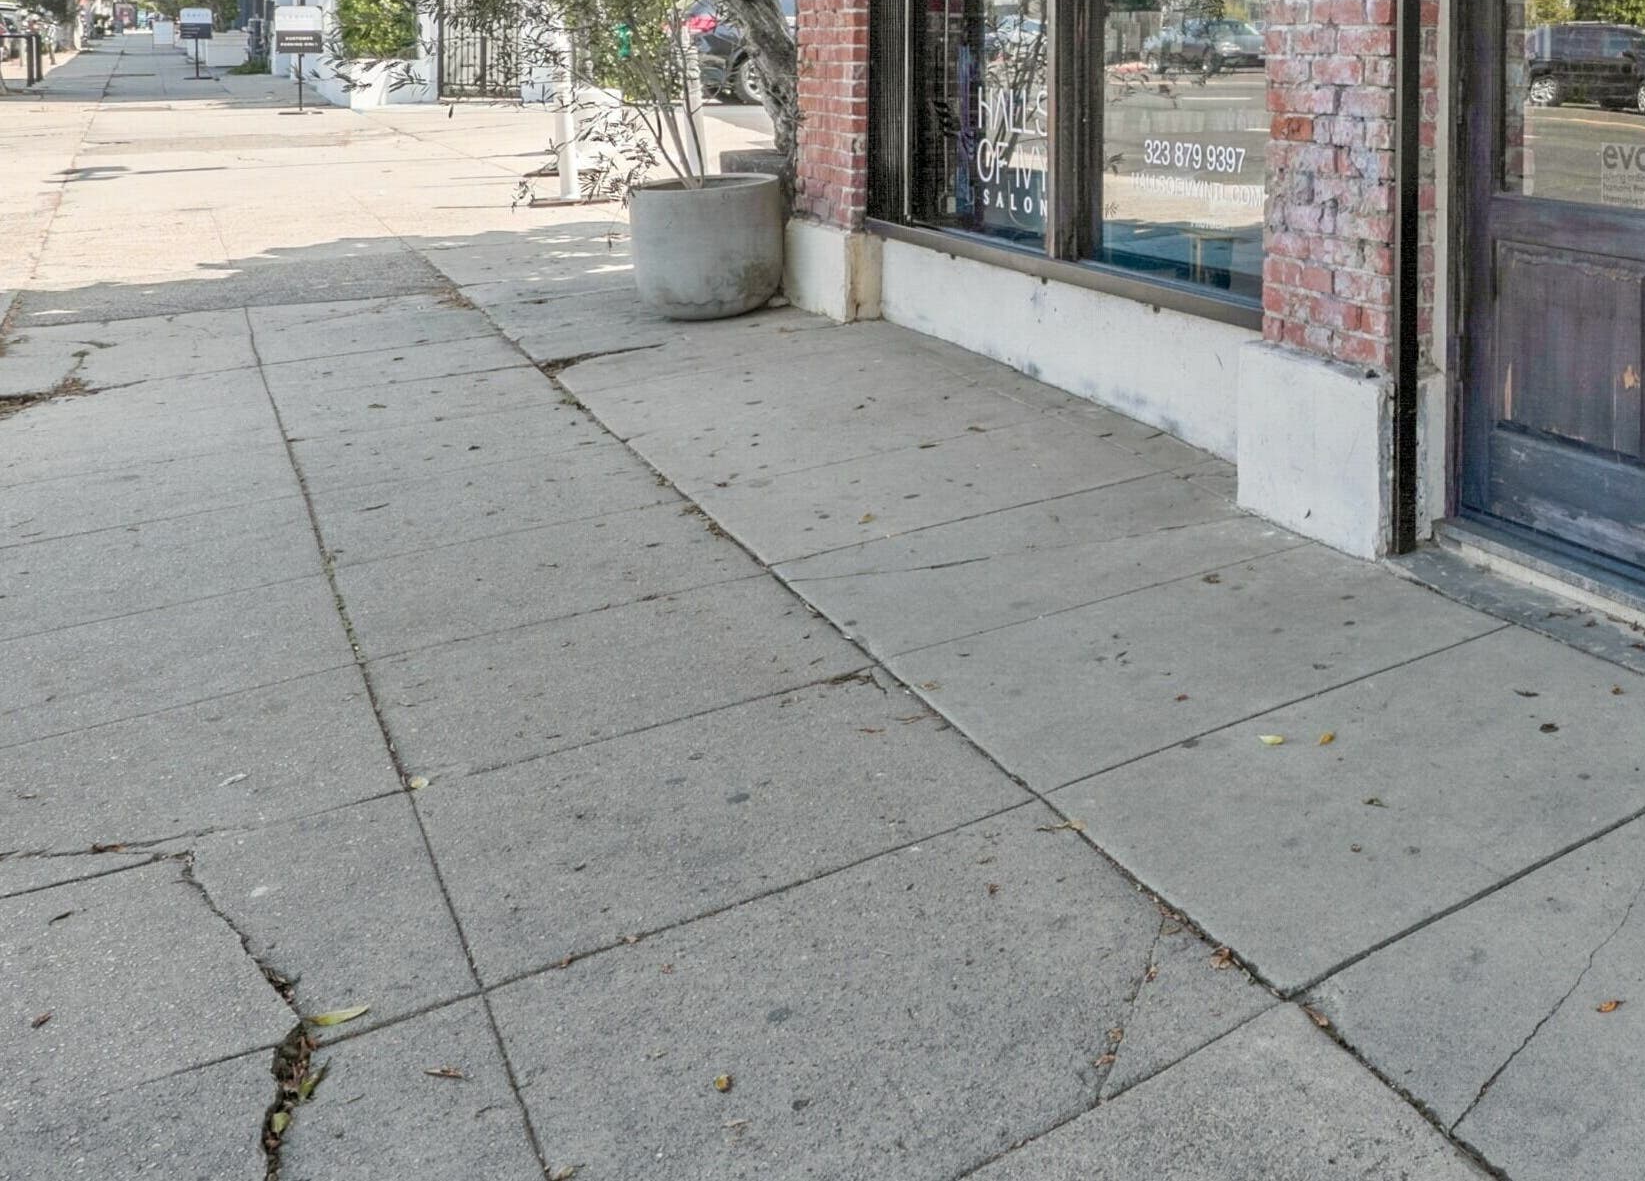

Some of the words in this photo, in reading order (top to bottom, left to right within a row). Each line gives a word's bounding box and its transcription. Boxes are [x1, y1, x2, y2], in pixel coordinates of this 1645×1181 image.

[977, 138, 1009, 185] OF
[1144, 139, 1171, 166] 323
[1174, 141, 1202, 170] 879
[1206, 145, 1246, 174] 9397
